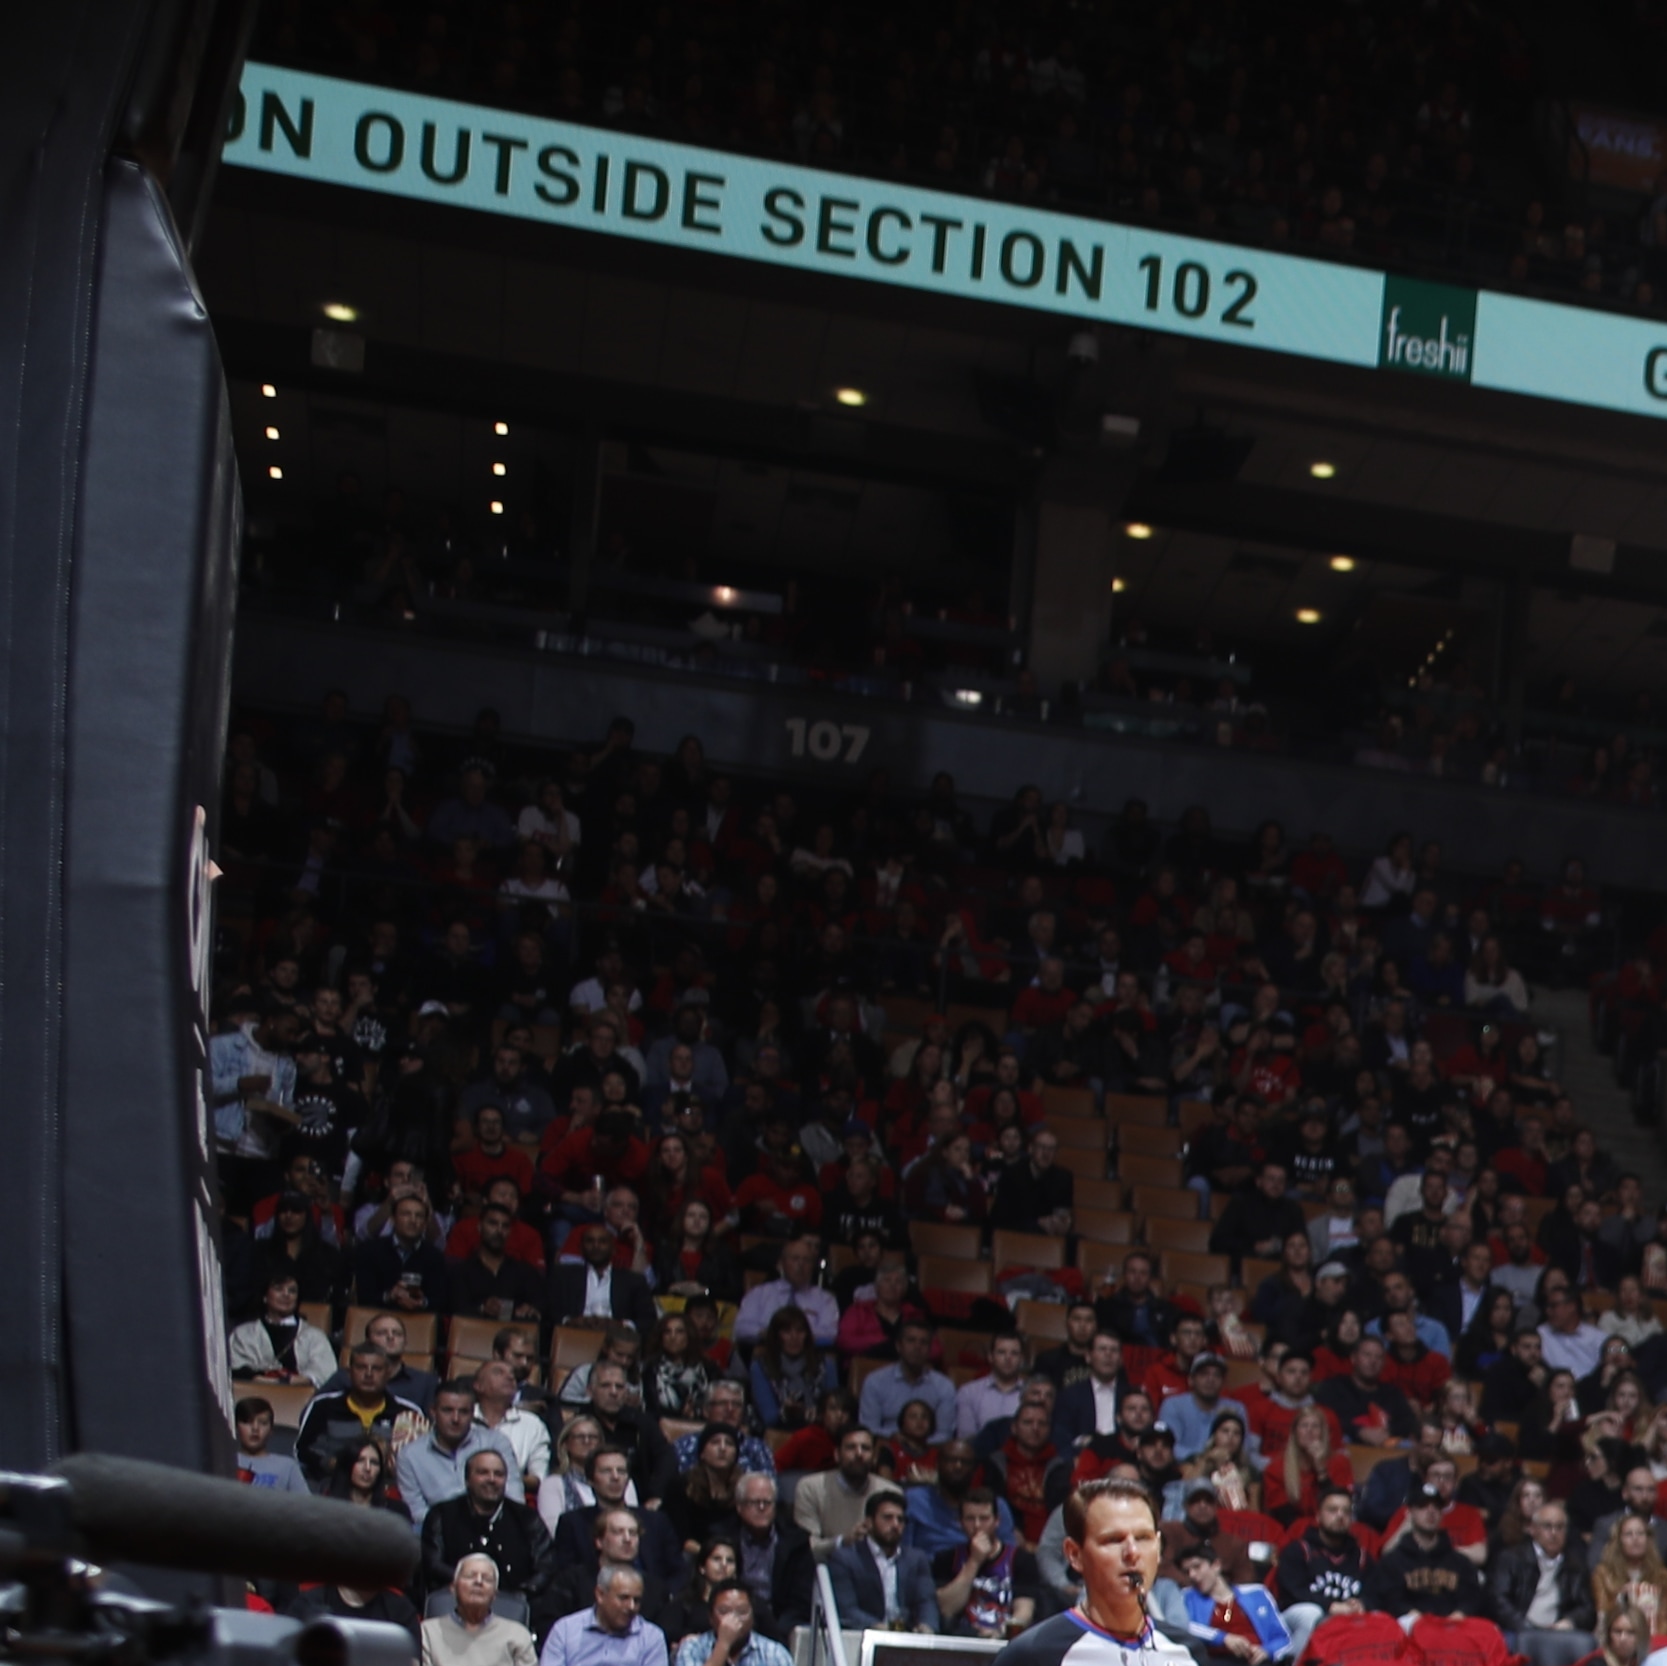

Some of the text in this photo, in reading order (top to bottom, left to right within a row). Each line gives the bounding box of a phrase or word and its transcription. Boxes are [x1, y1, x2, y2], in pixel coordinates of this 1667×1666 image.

[353, 110, 726, 236] OUTSIDE
[760, 186, 1105, 302] SECTION
[1138, 254, 1259, 328] 102
[1386, 306, 1469, 374] freshii
[785, 717, 871, 763] 107
